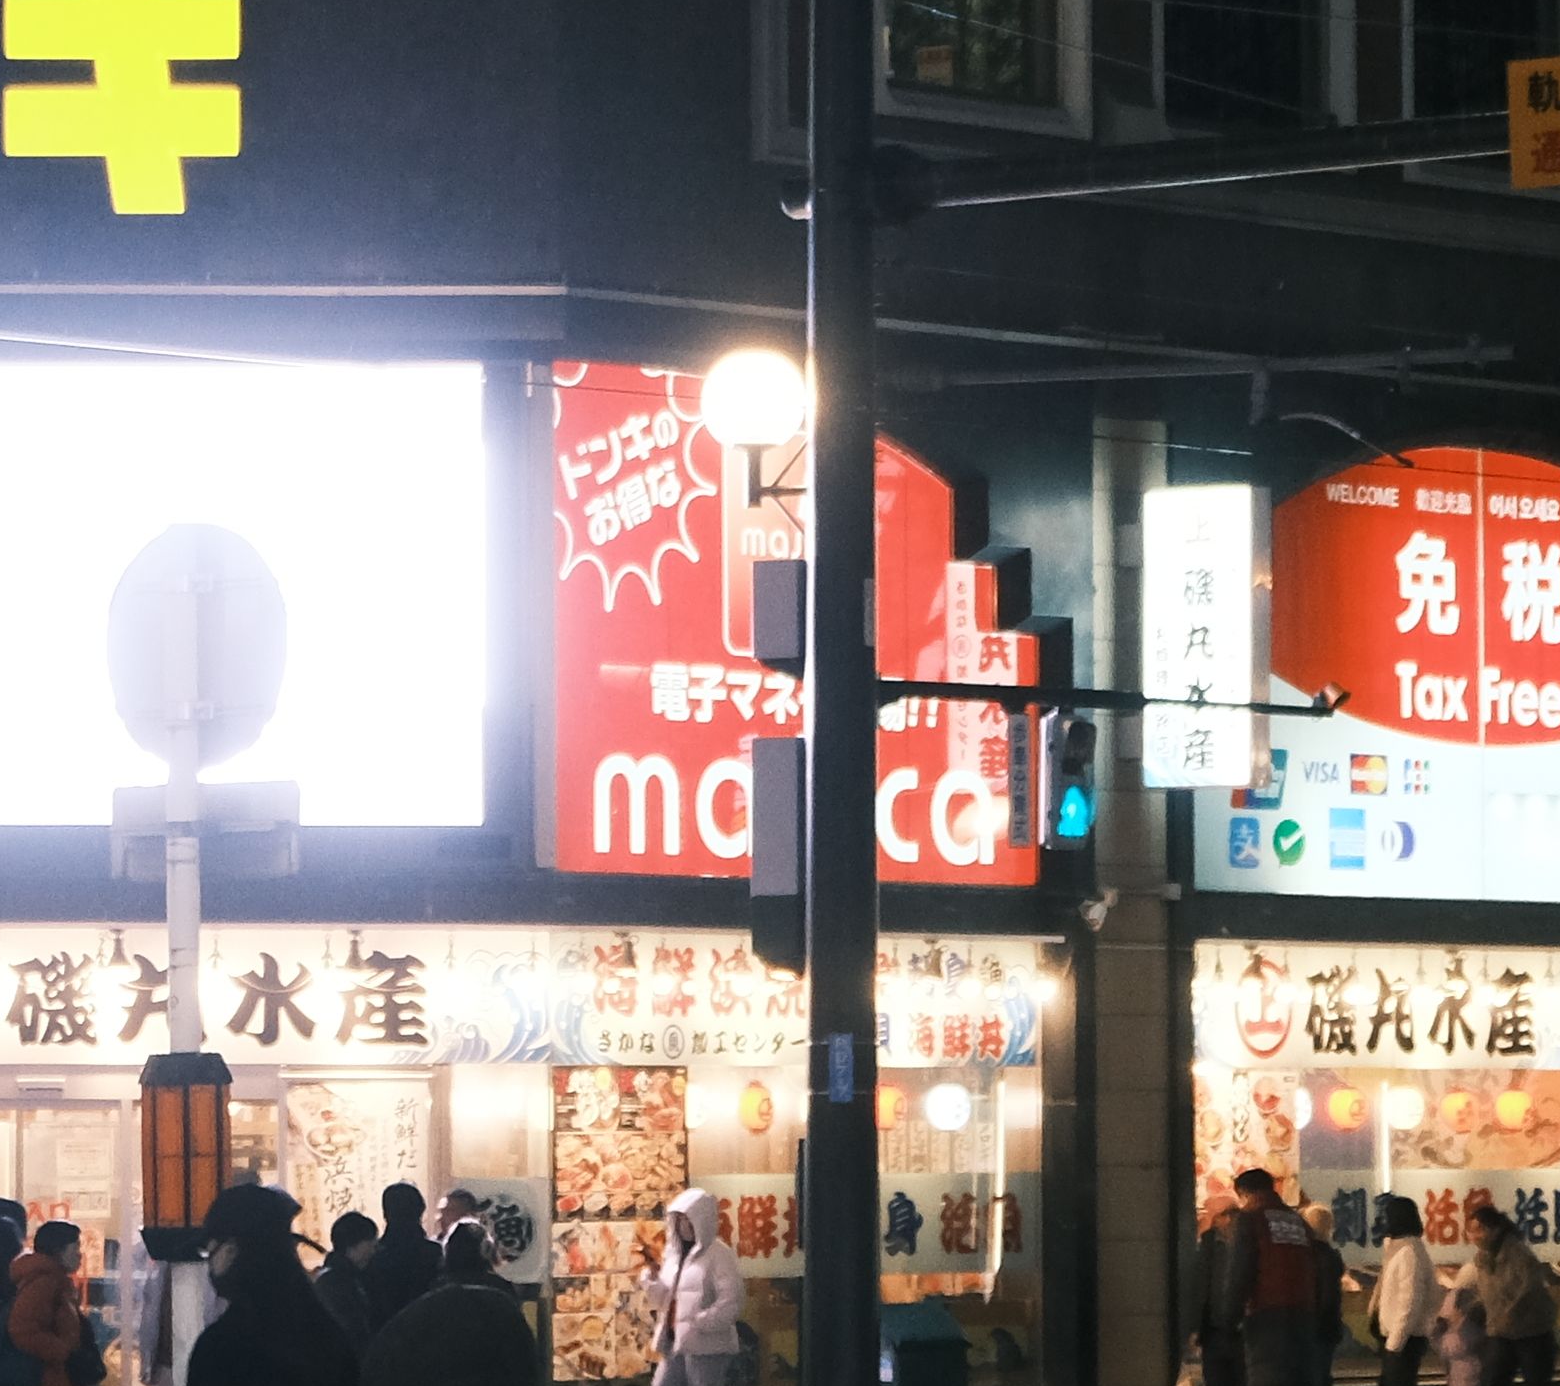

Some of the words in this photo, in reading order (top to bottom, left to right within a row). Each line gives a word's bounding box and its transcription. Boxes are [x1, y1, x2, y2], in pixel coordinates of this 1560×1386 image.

[560, 410, 680, 500] ドンキの
[1326, 482, 1399, 508] WELCOME
[583, 460, 683, 547] お得な
[1394, 659, 1469, 723] Tax
[1302, 761, 1340, 784] VISA
[5, 951, 432, 1049] 磯丸水産
[1304, 964, 1537, 1057] 磯丸水産
